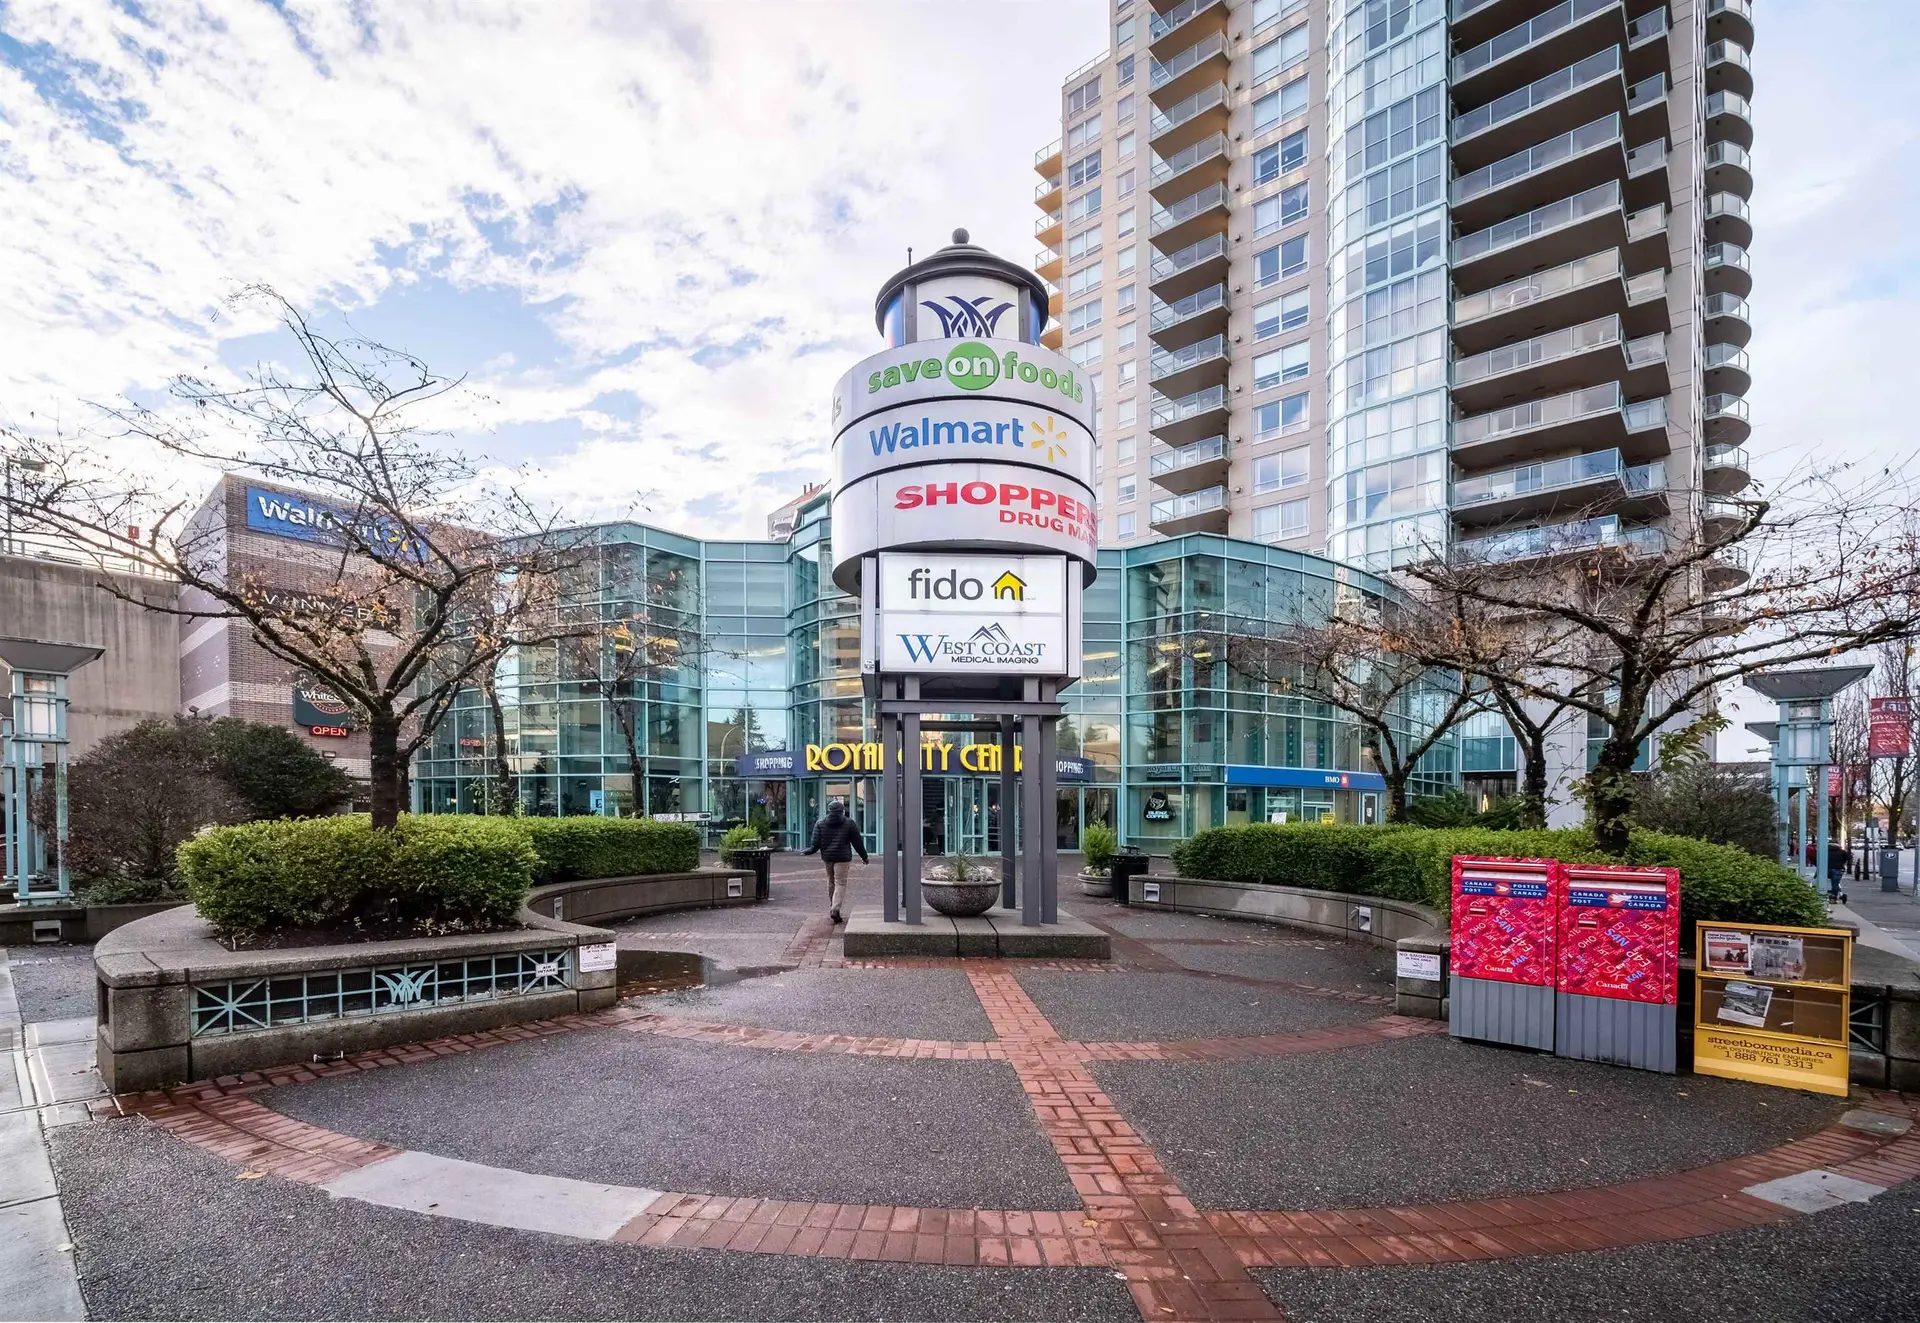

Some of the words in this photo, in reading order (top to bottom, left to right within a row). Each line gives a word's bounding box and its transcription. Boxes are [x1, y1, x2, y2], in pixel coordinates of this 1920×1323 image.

[868, 357, 942, 394] save
[948, 355, 995, 377] on
[1003, 351, 1084, 404] foods
[869, 417, 1024, 456] Walmart
[999, 510, 1064, 533] DRUG
[908, 568, 983, 600] fido
[896, 634, 975, 663] WEST
[982, 643, 1046, 656] COAST
[951, 656, 995, 664] MEDICAL
[997, 656, 1039, 665] IMAGING
[312, 726, 347, 736] OPEN
[754, 756, 793, 770] SHOPPING
[1325, 775, 1339, 784] BMO
[1492, 915, 1515, 933] S4N
[1604, 928, 1630, 946] S4N
[1707, 1035, 1834, 1059] streetboxmedia.ca
[1730, 1046, 1781, 1058] DISTRIBUTION
[1725, 1050, 1730, 1058] 1
[1734, 1052, 1756, 1061] 888
[1761, 1055, 1780, 1065] 761
[1784, 1059, 1814, 1070] 3313
